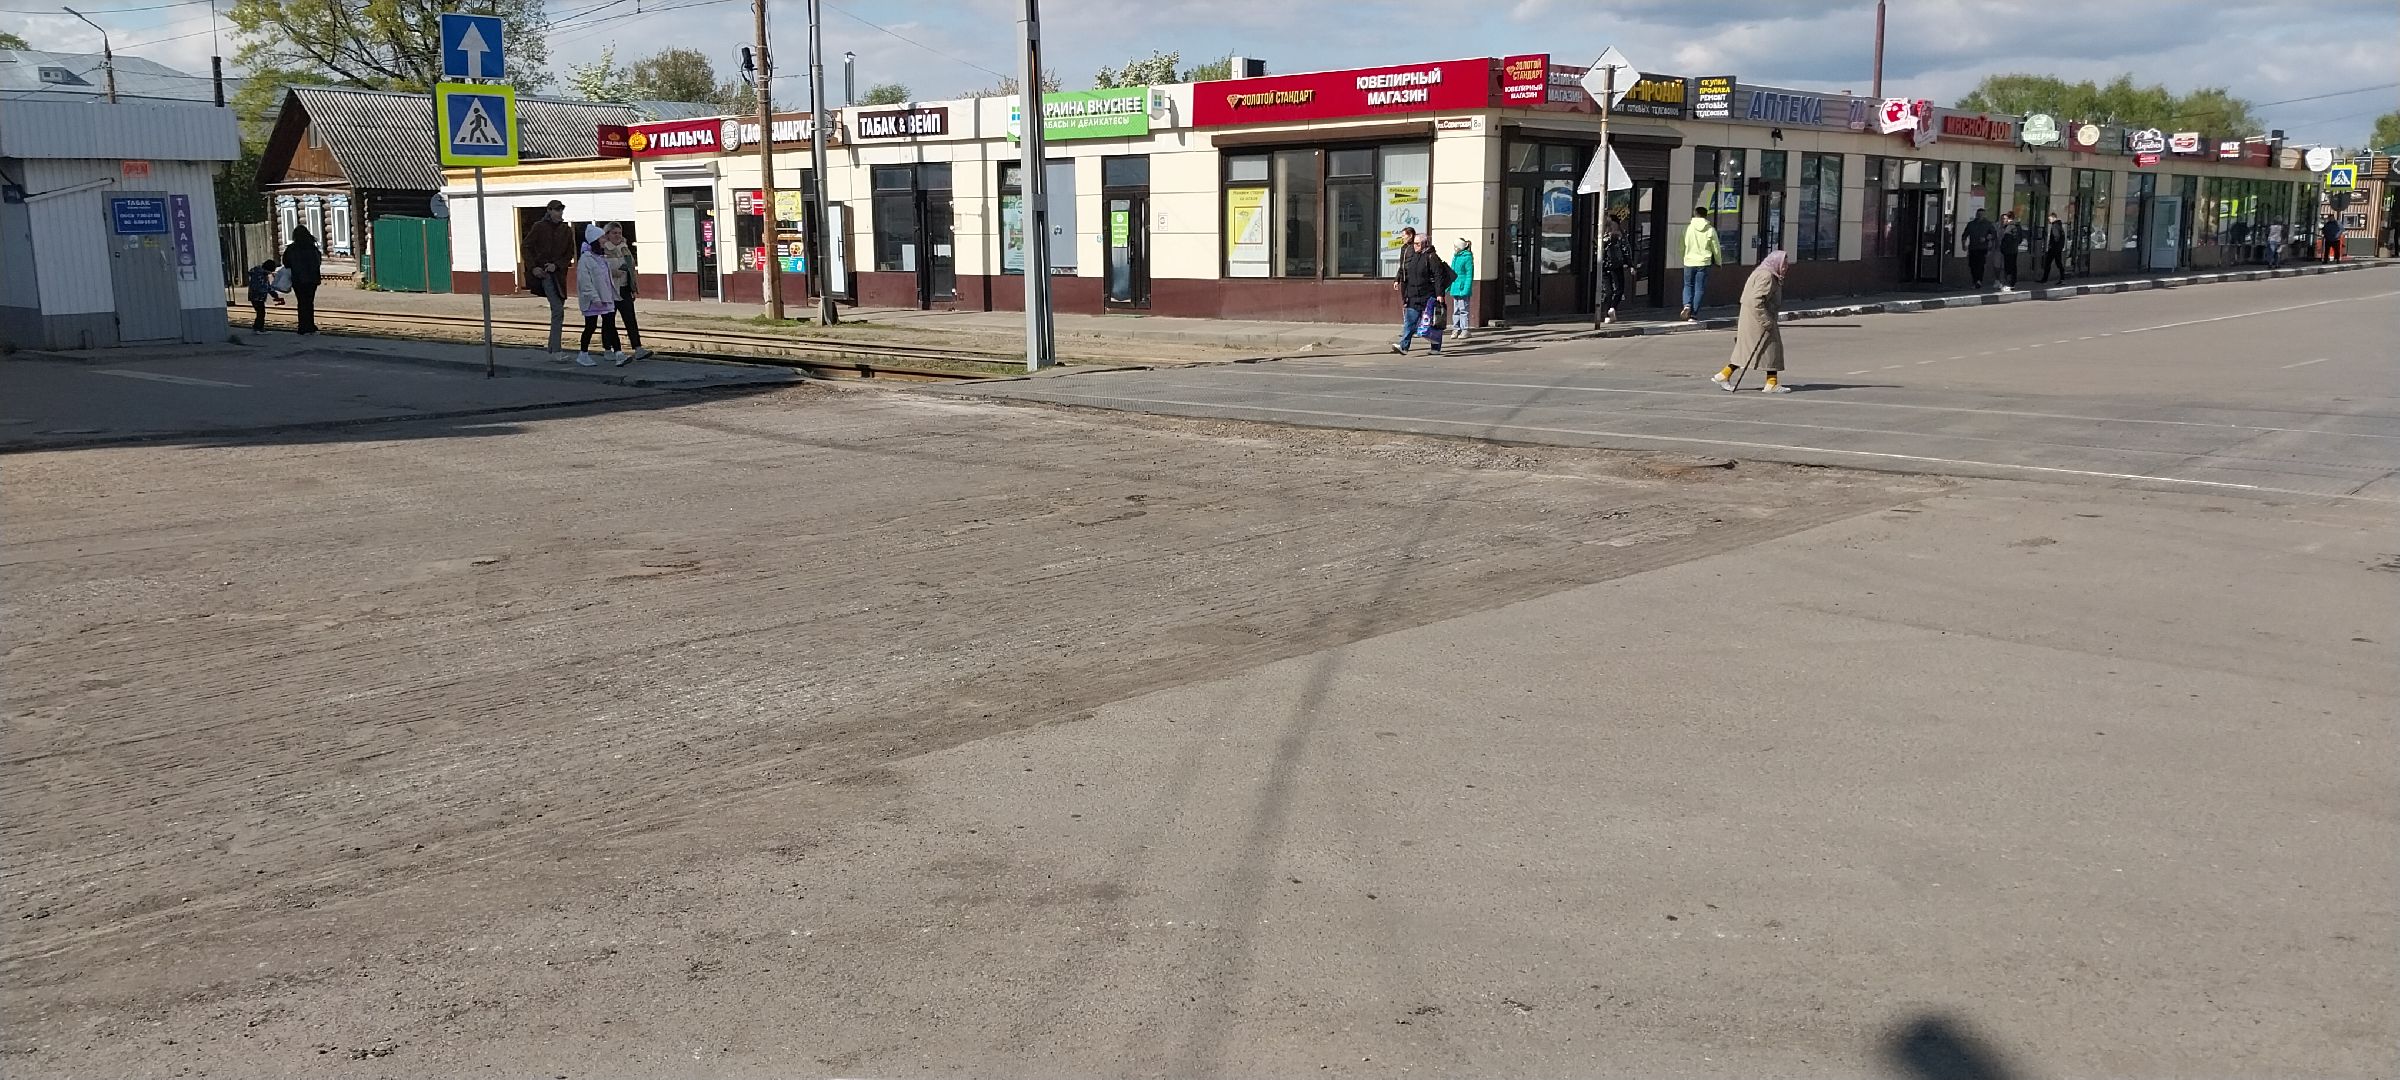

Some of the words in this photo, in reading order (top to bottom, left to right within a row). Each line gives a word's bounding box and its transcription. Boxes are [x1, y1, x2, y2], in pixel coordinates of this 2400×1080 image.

[1515, 59, 1542, 71] ЗОЛОТОЙ
[1356, 68, 1442, 89] ЮВЕЛИРНЫЙ
[1513, 70, 1543, 81] СТАНДАРТ
[1505, 84, 1543, 93] ЮВЕЛИРНЫЙ
[1701, 78, 1727, 87] СКУПКА
[1367, 89, 1428, 105] МАГАЗИН
[1511, 92, 1538, 100] МАГАЗИН
[1699, 86, 1731, 95] ПРОДАЖА
[1242, 91, 1274, 106] ЗОЛОТОЙ
[1275, 91, 1314, 104] СТАНДАРТ
[1699, 94, 1727, 102] РЕМОНТ
[1088, 97, 1142, 113] ВКУСНЕЕ
[1696, 101, 1728, 109] СОТОВЫХ
[1746, 91, 1823, 125] АПТЕКА
[1696, 109, 1729, 118] ТЕЛЕФОНОВ
[860, 116, 897, 136] ТАБАК
[898, 118, 906, 133] &
[907, 110, 941, 134] ВЕЙП
[1044, 119, 1068, 128] ЛБАСЫ
[1071, 119, 1076, 127] И
[1078, 117, 1129, 128] ДЕЛИКАТЕСЫ
[1946, 115, 1989, 139] МЯСНОЙ
[1991, 122, 2012, 141] ДОМ
[649, 134, 658, 149] У
[660, 130, 715, 148] ПАЛЫЧА
[740, 124, 761, 143] КАФ
[176, 198, 189, 252] ТАБАК
